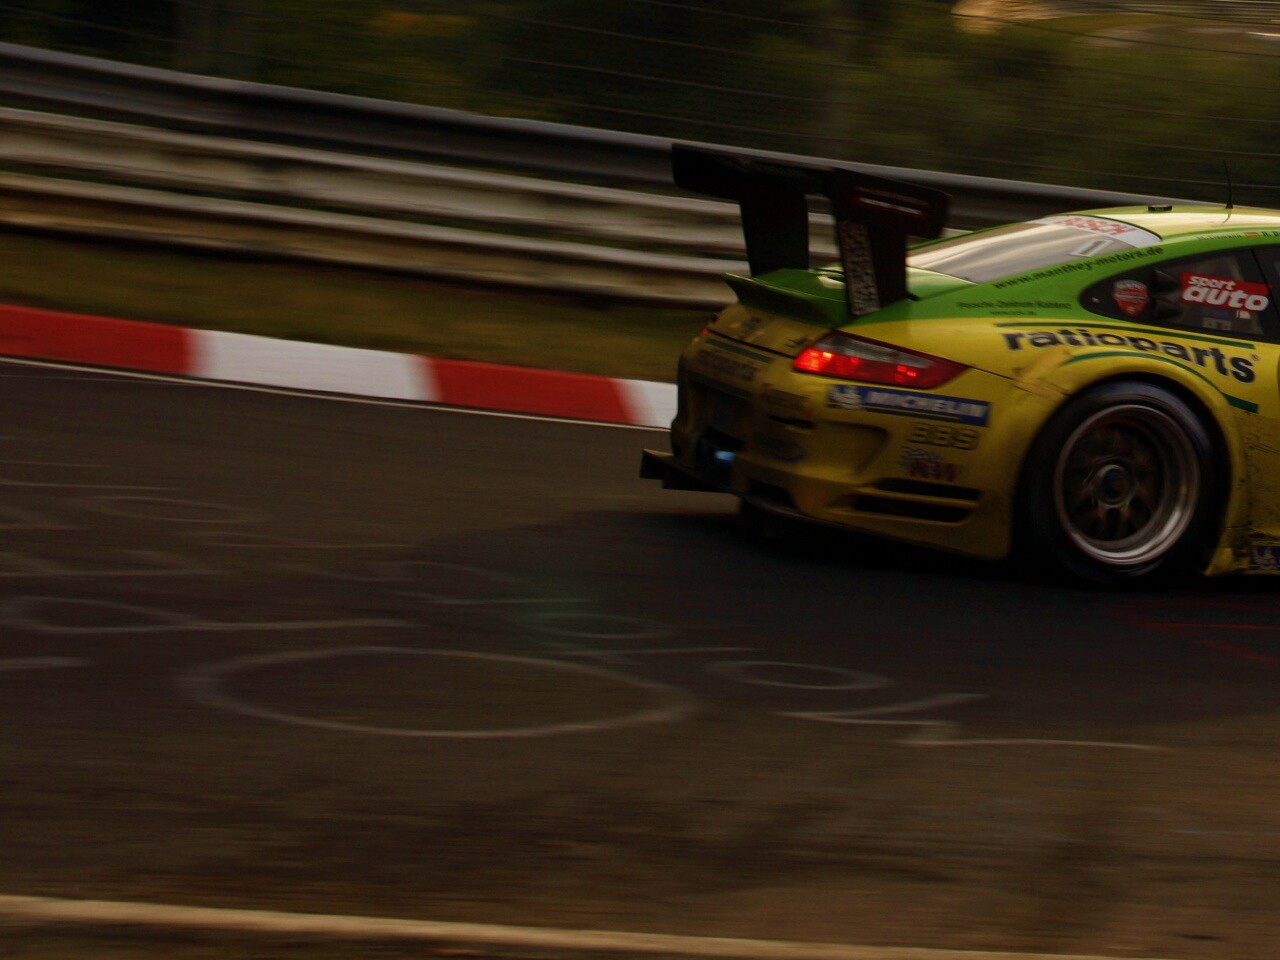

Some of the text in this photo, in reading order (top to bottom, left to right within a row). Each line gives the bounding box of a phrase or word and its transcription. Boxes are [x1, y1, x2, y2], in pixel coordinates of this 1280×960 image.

[1188, 275, 1236, 291] sport
[1181, 284, 1270, 312] auto
[1002, 328, 1256, 384] ratioparts
[865, 391, 989, 418] MICHELIN
